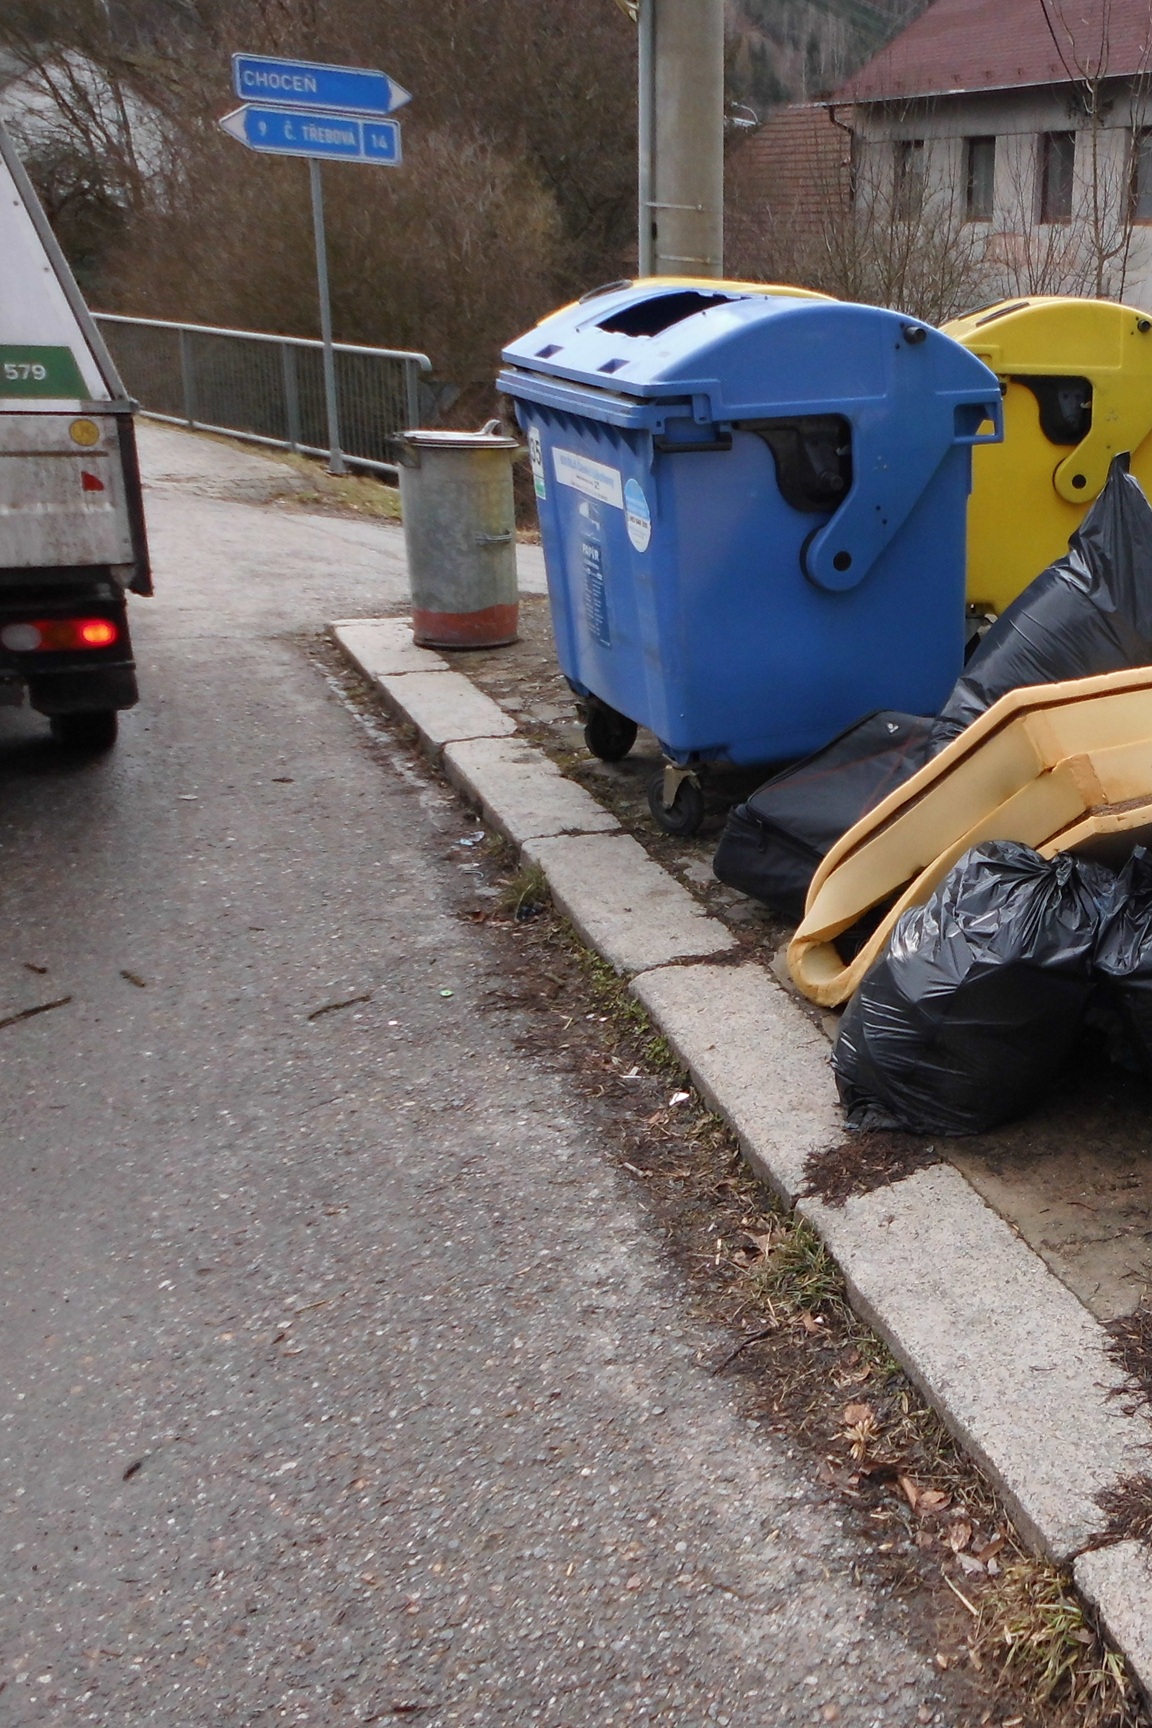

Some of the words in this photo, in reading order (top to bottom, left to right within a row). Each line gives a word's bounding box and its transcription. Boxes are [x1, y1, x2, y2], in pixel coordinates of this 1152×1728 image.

[242, 69, 317, 93] CHOCEŇ
[257, 120, 267, 136] 9
[371, 133, 388, 149] 14
[4, 363, 47, 380] 579
[530, 437, 543, 466] 35
